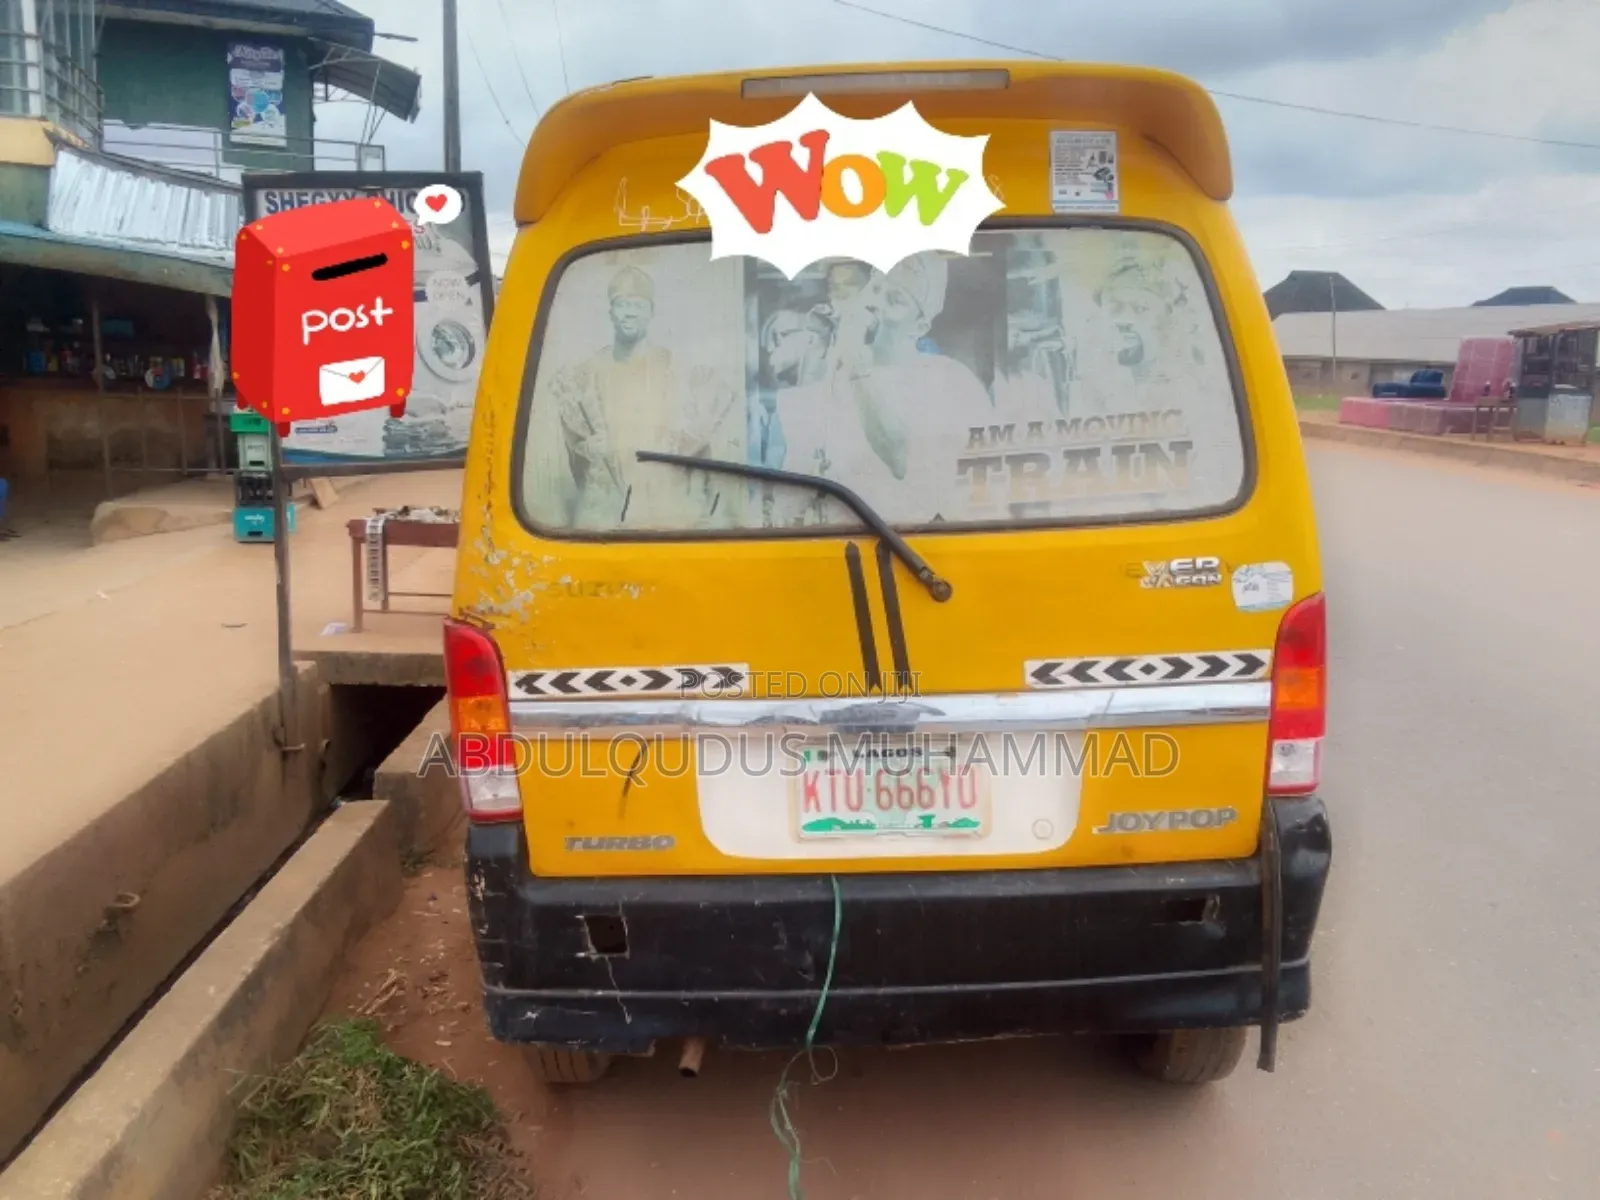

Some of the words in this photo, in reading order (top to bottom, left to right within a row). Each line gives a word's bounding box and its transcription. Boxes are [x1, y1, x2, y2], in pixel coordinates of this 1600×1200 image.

[968, 424, 1016, 448] AM
[1026, 421, 1044, 440] A
[1054, 409, 1185, 436] MOVING
[956, 440, 1193, 503] TRAIN
[564, 835, 676, 852] TURBO
